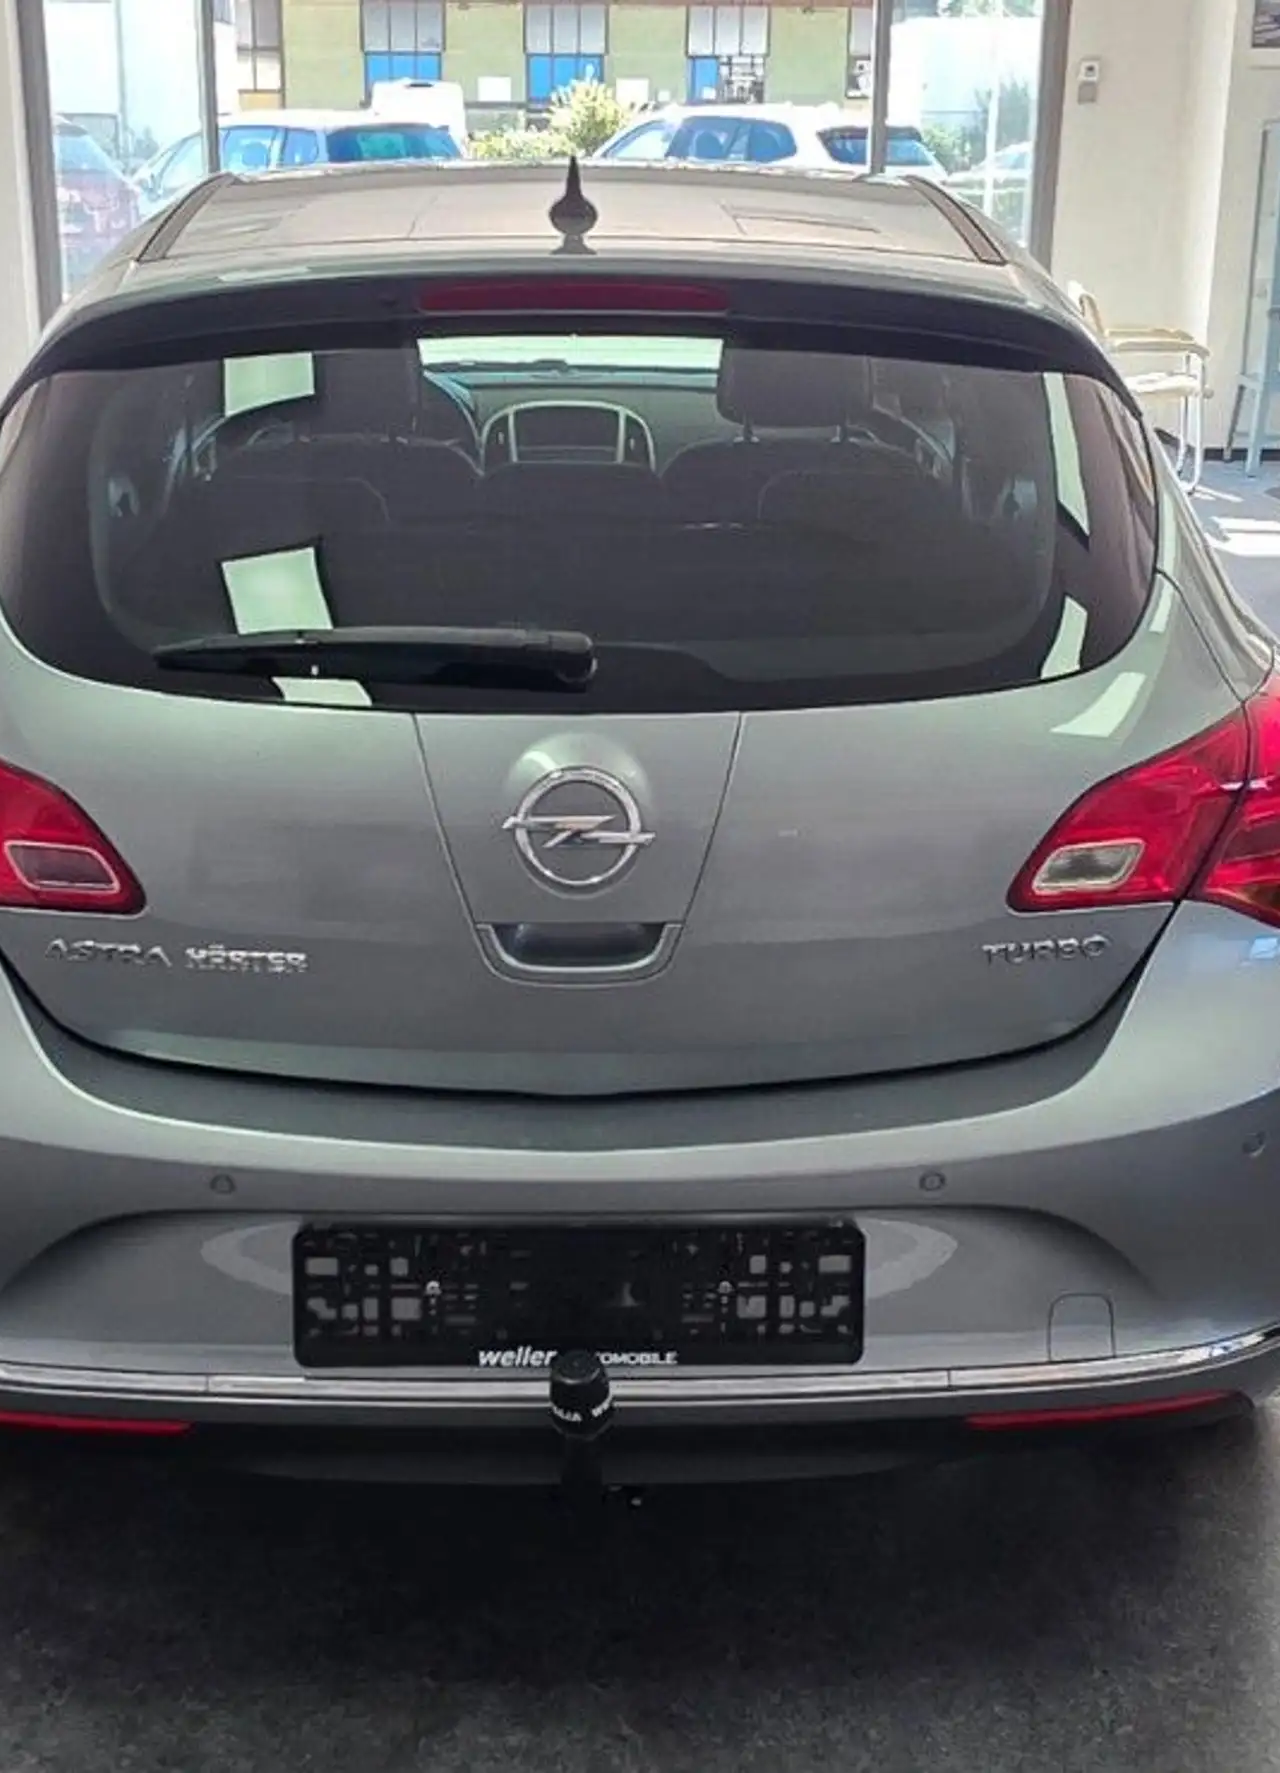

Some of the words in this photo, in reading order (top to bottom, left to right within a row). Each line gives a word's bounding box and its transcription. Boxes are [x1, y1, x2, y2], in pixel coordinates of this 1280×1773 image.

[45, 938, 172, 967] ASTRA
[981, 934, 1110, 965] TURBO
[477, 1345, 558, 1367] weller
[595, 1351, 679, 1366] OMOBILE
